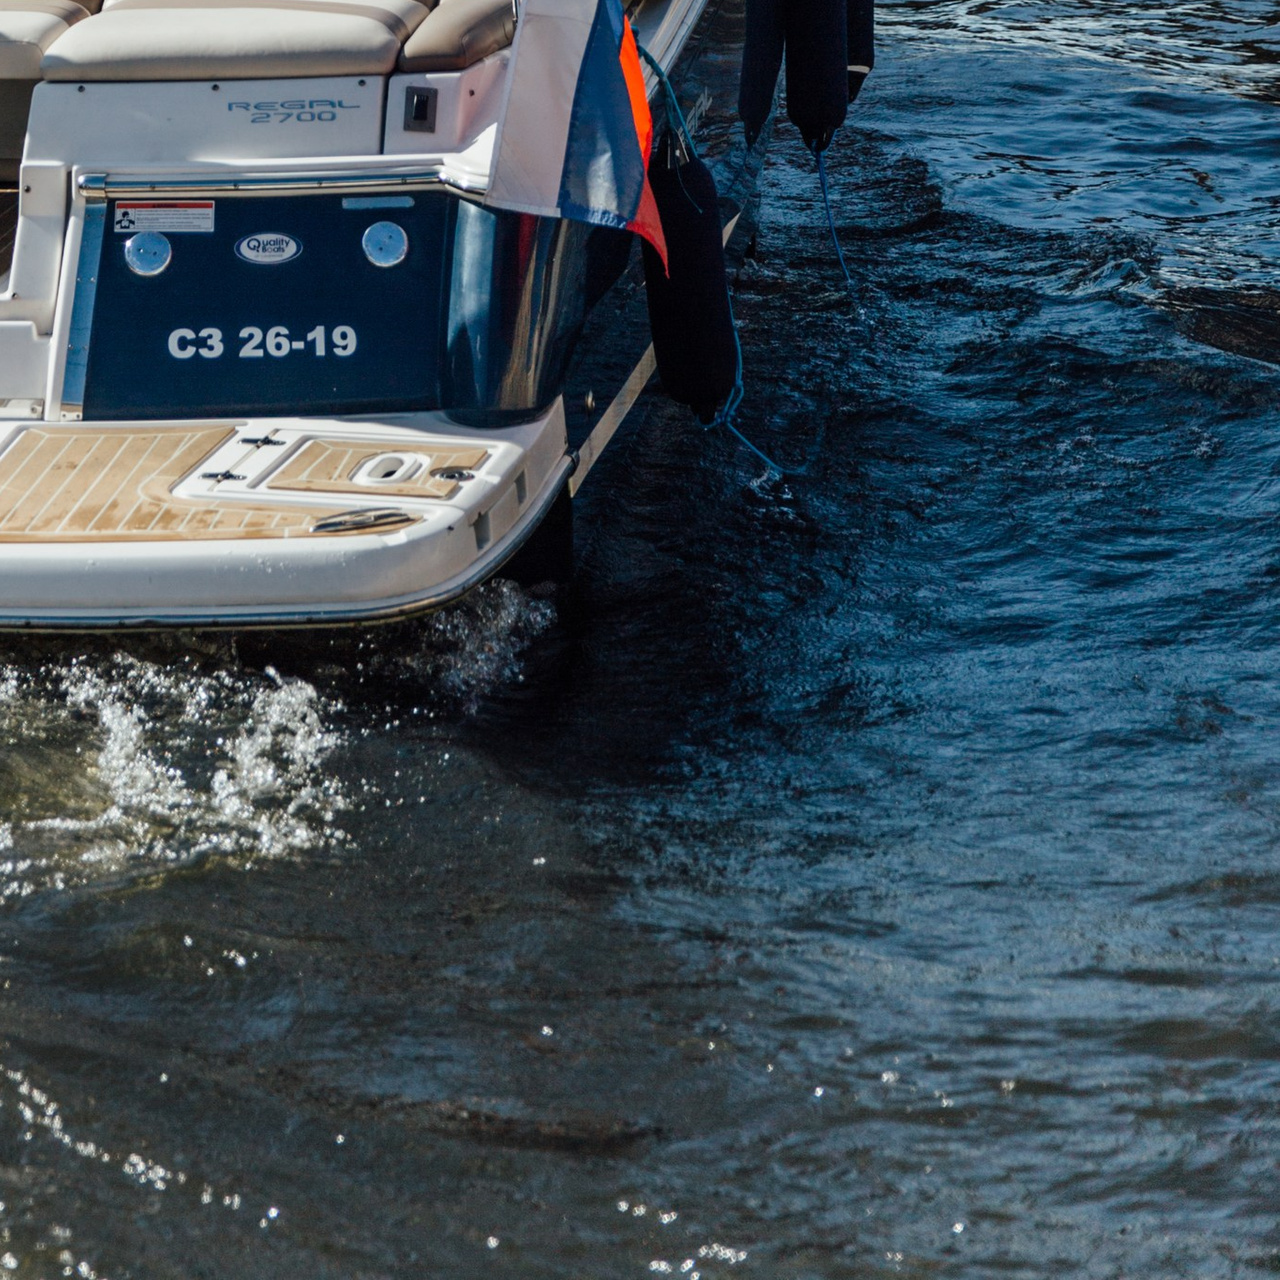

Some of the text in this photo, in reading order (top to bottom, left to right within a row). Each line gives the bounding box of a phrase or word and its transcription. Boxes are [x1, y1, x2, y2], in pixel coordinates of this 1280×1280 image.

[228, 100, 360, 111] REGAL
[251, 111, 336, 123] 2700
[247, 237, 290, 253] Quality
[262, 245, 285, 253] Boats
[239, 325, 358, 357] 26-19
